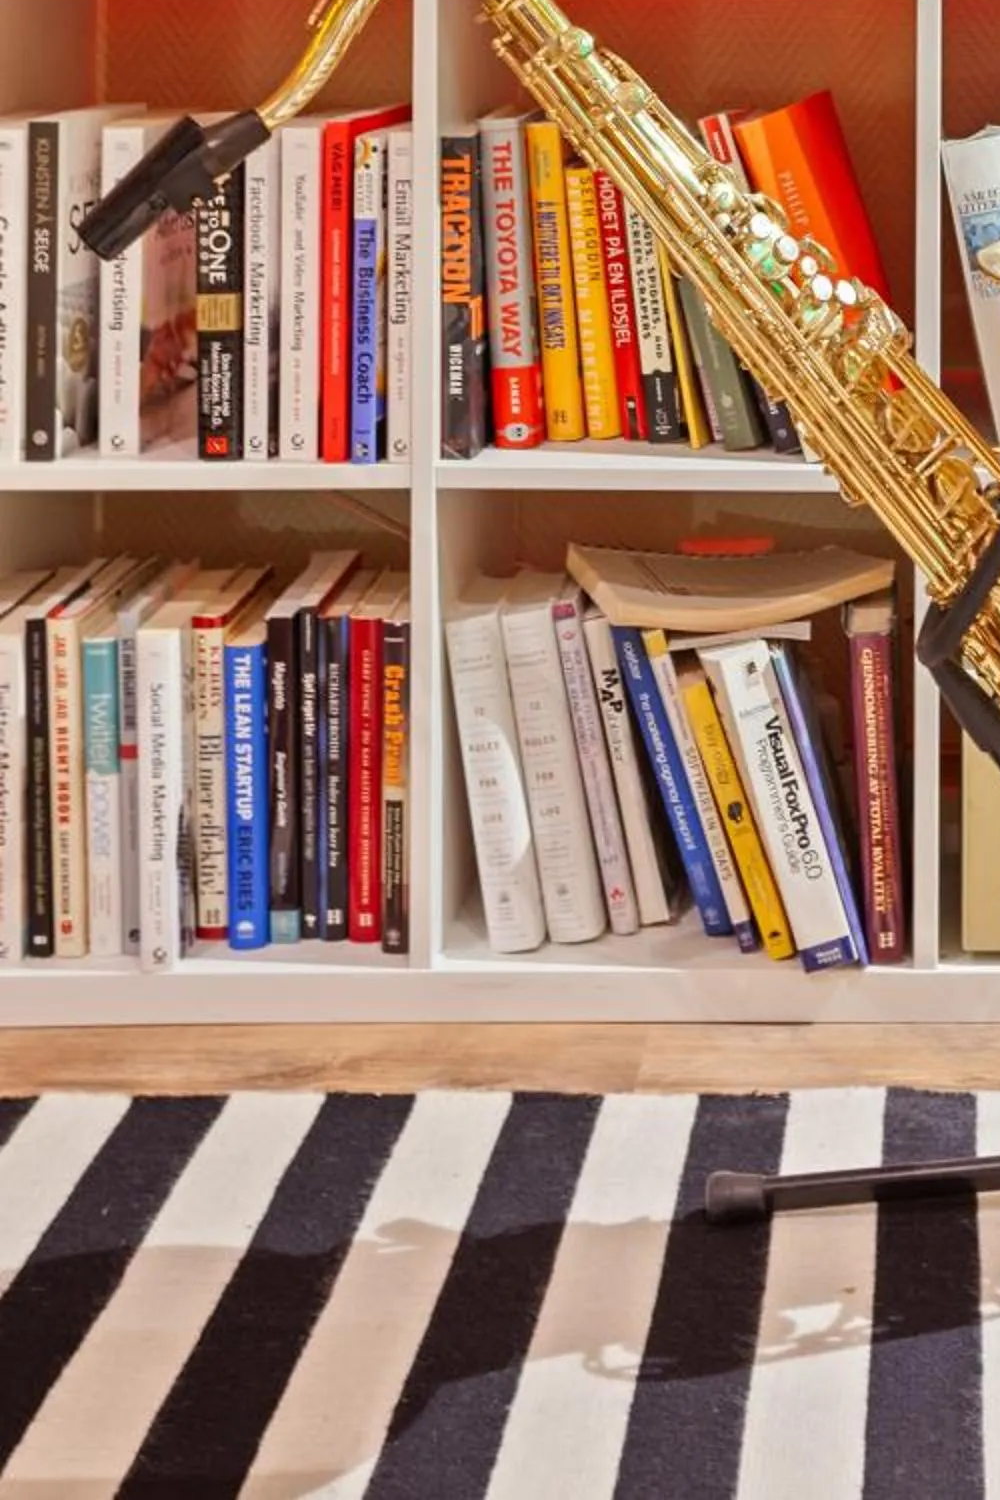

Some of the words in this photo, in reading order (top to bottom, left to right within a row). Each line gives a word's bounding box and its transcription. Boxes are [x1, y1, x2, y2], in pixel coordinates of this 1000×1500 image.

[493, 141, 514, 193] THE
[248, 176, 265, 254] Facebook
[395, 179, 412, 227] Email
[580, 175, 595, 218] SETH
[598, 176, 619, 233] HODET
[358, 229, 373, 259] The
[443, 155, 471, 304] TRACTION
[495, 198, 519, 294] TOYOTA
[583, 227, 600, 282] GODIN
[606, 236, 624, 257] PÅ
[207, 229, 232, 284] ONE
[390, 234, 411, 325] Marketing
[608, 262, 624, 285] EN
[109, 253, 128, 332] dvertising
[241, 262, 264, 346] Marketing
[356, 267, 374, 344] Business
[290, 291, 305, 351] Marketing
[501, 302, 522, 357] WAY
[356, 352, 373, 404] Coach
[234, 654, 251, 689] THE
[272, 661, 287, 711] Magento
[384, 665, 405, 726] Crash
[150, 683, 165, 727] Social
[234, 692, 252, 739] LEAN
[57, 727, 70, 775] RIGHT
[151, 734, 165, 780] Media
[199, 734, 221, 769] Bli
[58, 782, 71, 824] HOOK
[199, 774, 218, 810] mer
[235, 744, 253, 820] STARTUP
[756, 738, 791, 833] Programmer's
[780, 833, 801, 874] Guide
[764, 715, 793, 780] Visual
[781, 780, 812, 849] FoxPro
[800, 849, 823, 881] 6.0
[868, 779, 880, 796] AV
[148, 785, 166, 862] Marketing
[237, 825, 253, 865] ERIC
[870, 798, 883, 844] TOTAL
[199, 813, 224, 897] effektiv!
[238, 870, 253, 911] RIES
